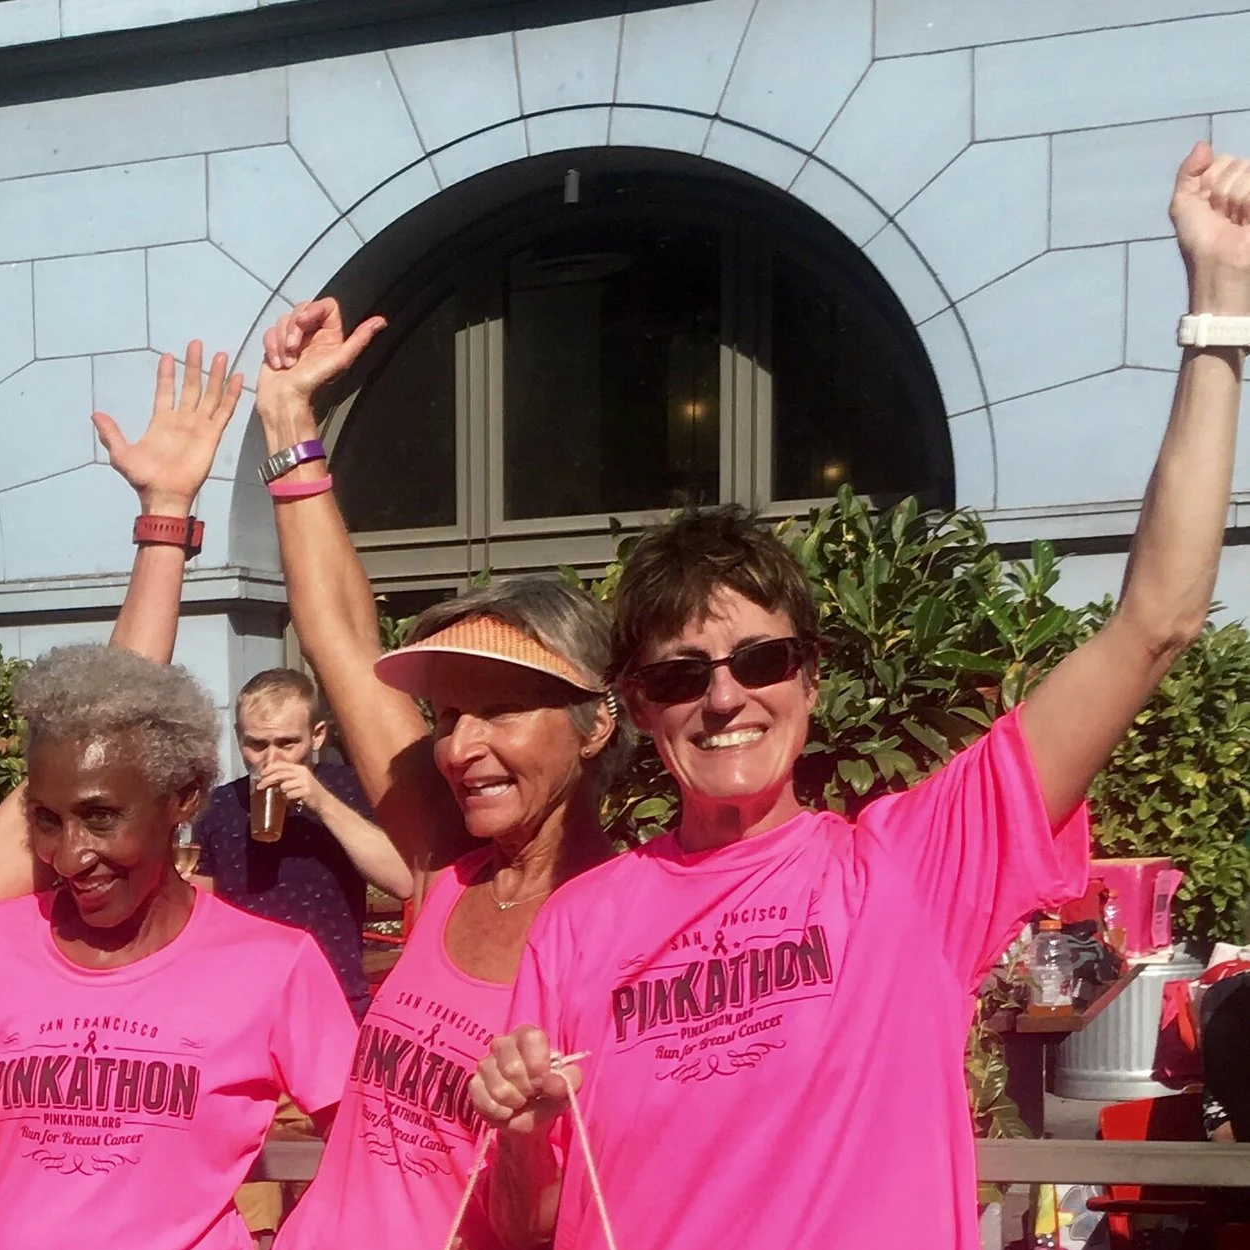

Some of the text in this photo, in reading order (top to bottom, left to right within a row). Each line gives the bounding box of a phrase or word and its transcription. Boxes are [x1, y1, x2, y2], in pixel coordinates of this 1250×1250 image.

[670, 931, 702, 951] SAN
[611, 924, 833, 1043] PINKATHON
[396, 992, 423, 1010] SAN
[39, 1016, 158, 1039] SAN FRANCISCO
[655, 1015, 784, 1061] Run for Breast Cancer
[43, 1113, 121, 1129] PINKATHON.ORG
[20, 1125, 144, 1147] Run for Breast Cancer
